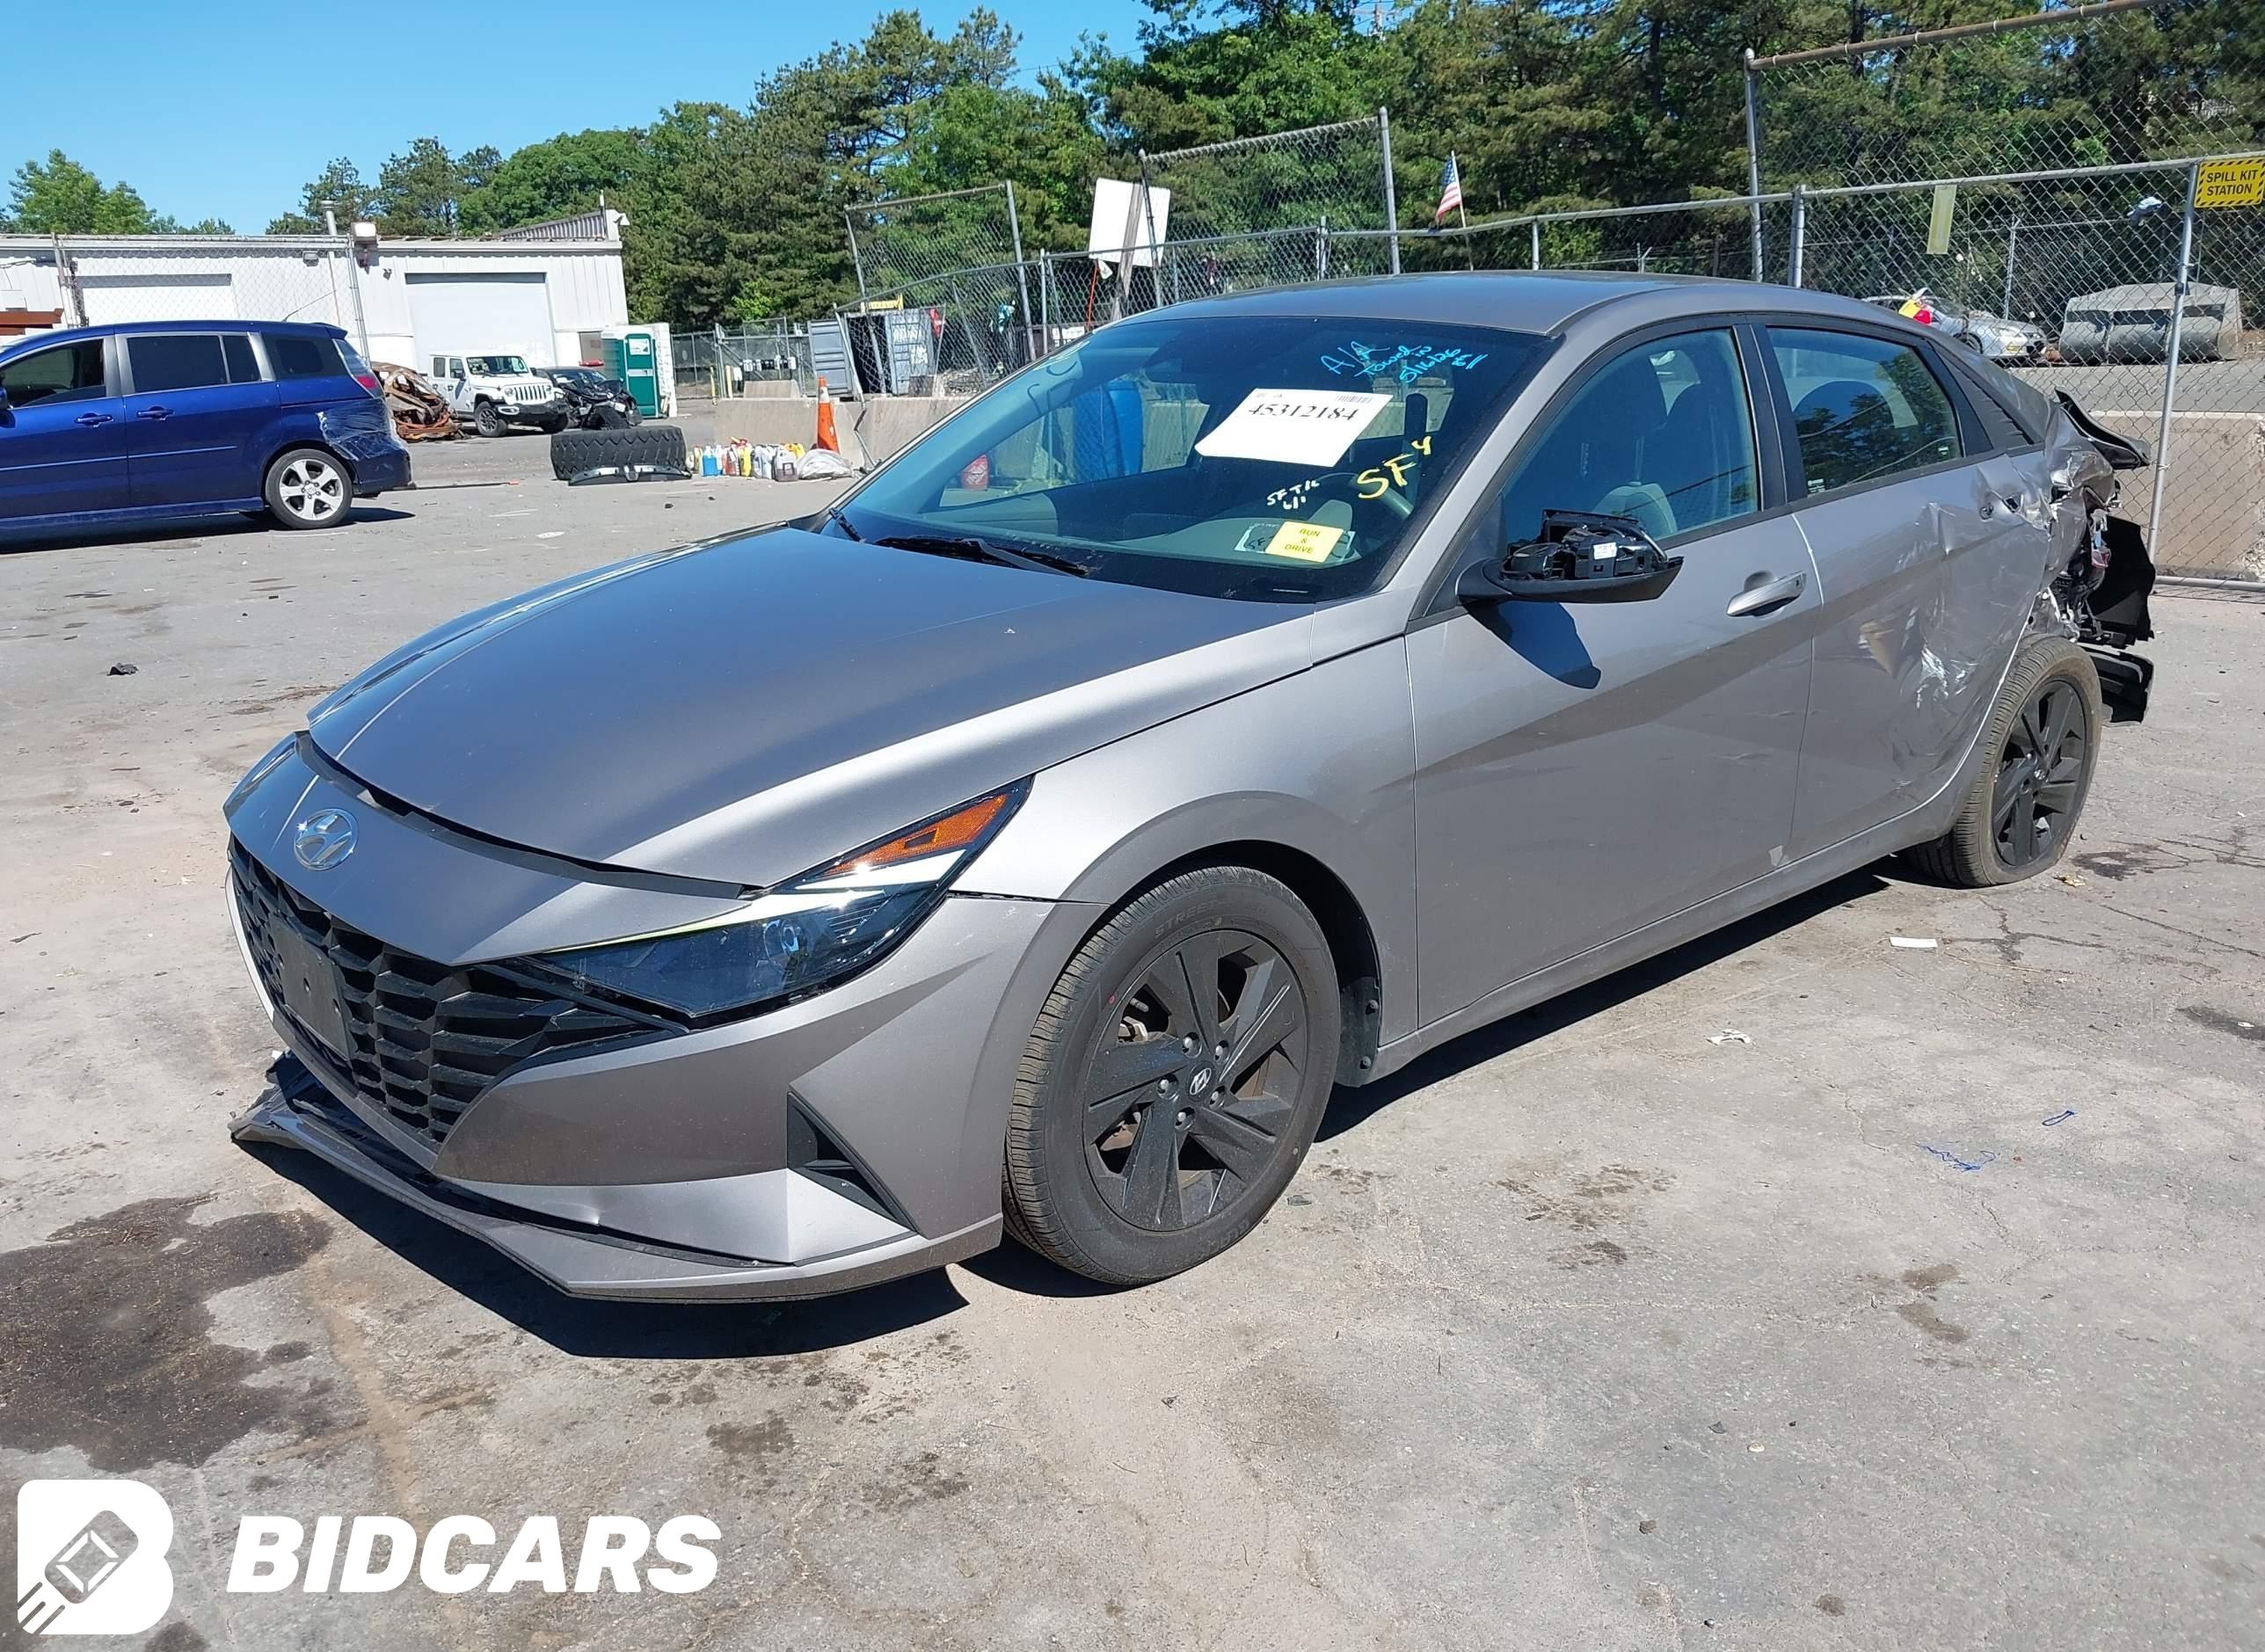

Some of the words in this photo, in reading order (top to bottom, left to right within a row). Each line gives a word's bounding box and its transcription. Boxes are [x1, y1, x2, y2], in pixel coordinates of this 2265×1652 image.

[2207, 171, 2236, 183] SPILL
[2240, 170, 2258, 181] KIT
[2207, 184, 2253, 196] STATION
[1248, 403, 1358, 421] 45312184
[1299, 528, 1321, 537] RUN
[1285, 543, 1315, 554] DRIVE
